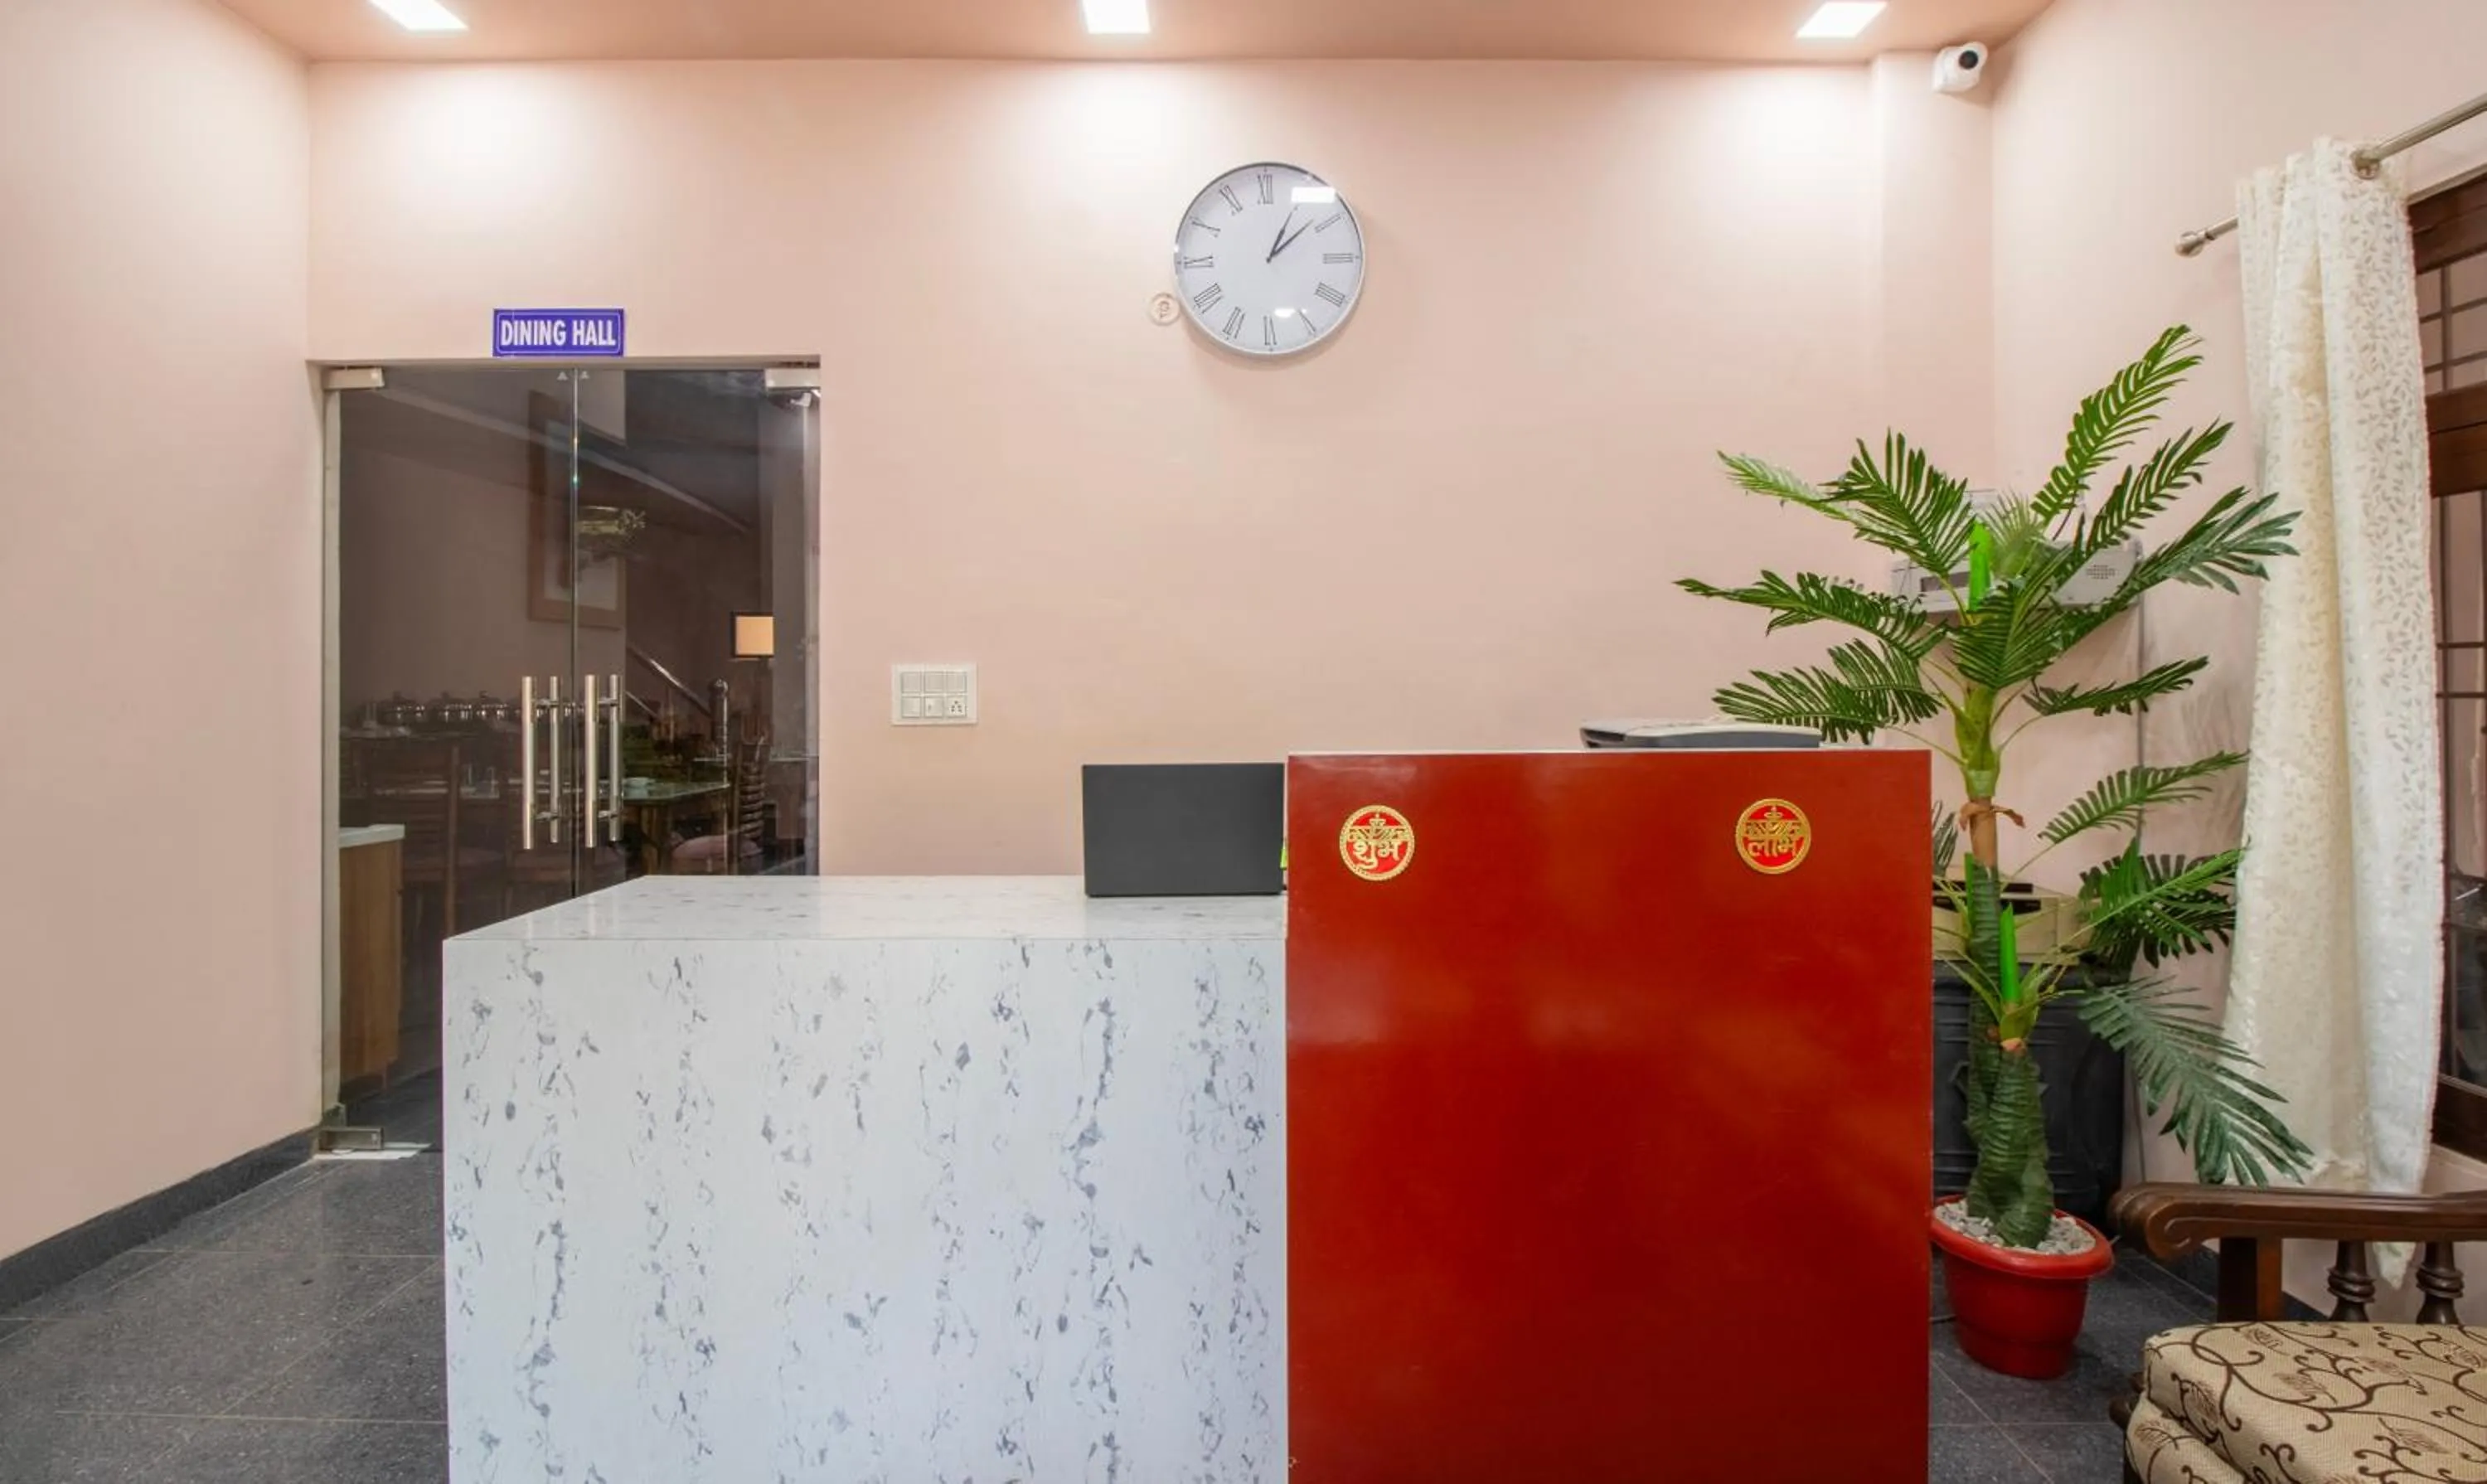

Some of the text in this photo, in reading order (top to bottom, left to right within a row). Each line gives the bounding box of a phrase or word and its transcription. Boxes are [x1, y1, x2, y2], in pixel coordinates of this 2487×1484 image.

[500, 319, 617, 347] DINING HALL
[1350, 837, 1408, 870] शुभ
